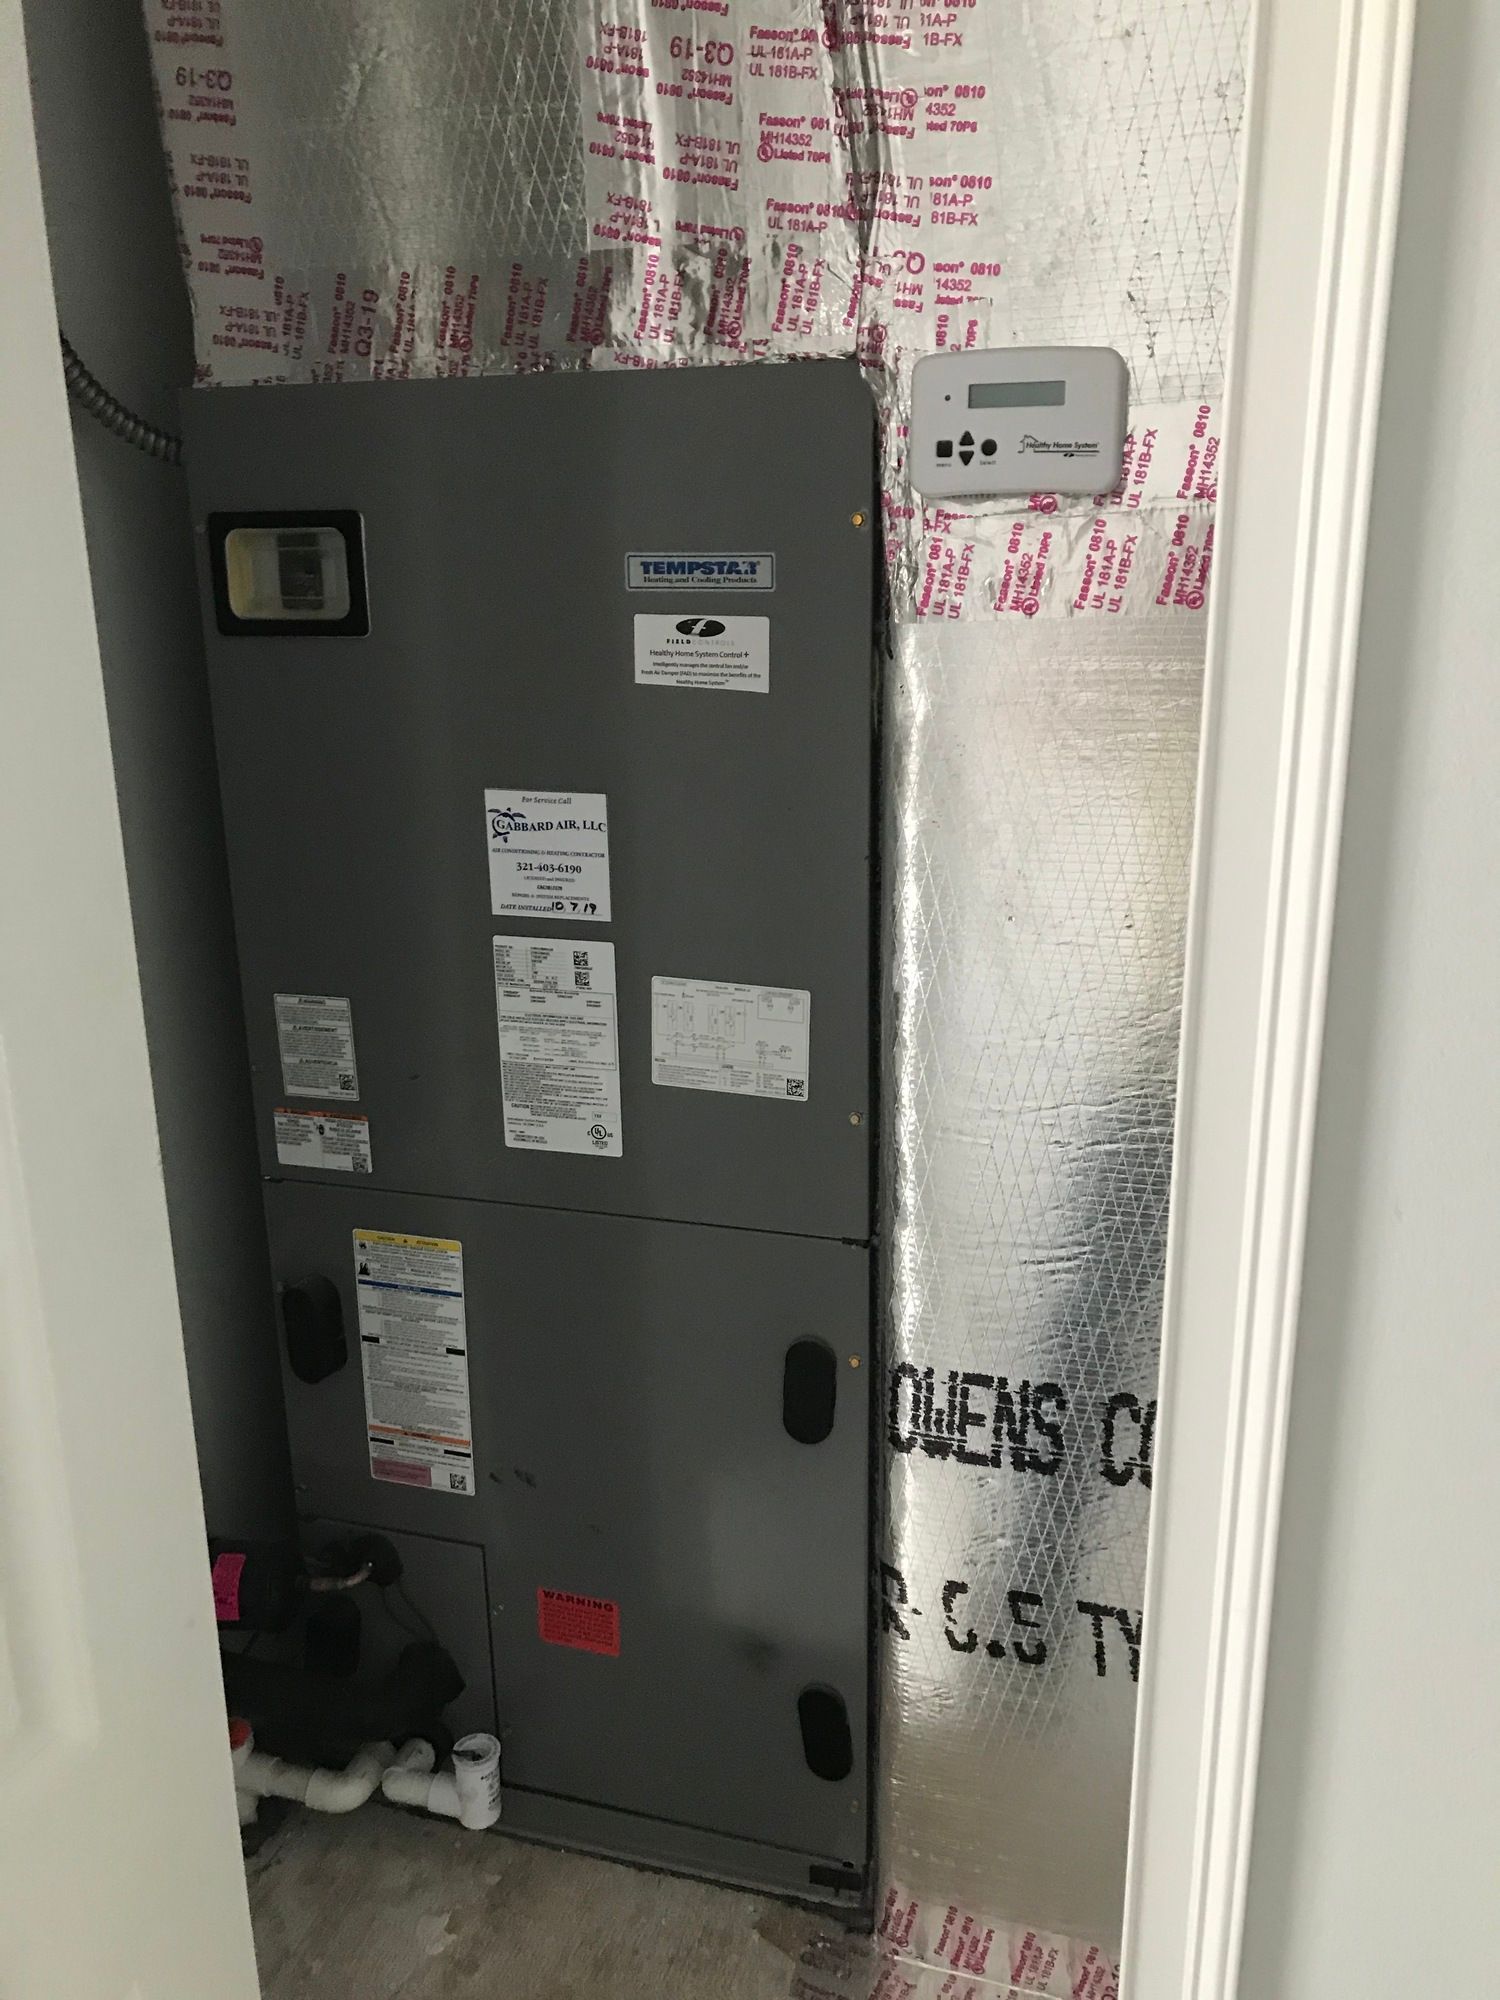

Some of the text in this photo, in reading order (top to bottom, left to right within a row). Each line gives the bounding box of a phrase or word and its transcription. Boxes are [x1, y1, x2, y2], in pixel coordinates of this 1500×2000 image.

[669, 36, 734, 66] Q3-19
[771, 46, 813, 61] 181A-P
[768, 64, 819, 80] 181B-FX
[954, 85, 986, 100] 0810
[675, 132, 741, 155] UL 181B-FX
[760, 130, 813, 147] MH14352
[679, 153, 738, 173] UL 181A-P
[960, 175, 993, 190] 0810
[768, 217, 829, 233] UL 181A-P
[644, 254, 661, 286] 0810
[783, 243, 801, 277] 0810
[970, 262, 1001, 277] 0810
[648, 273, 671, 340] UL 181A-P
[786, 263, 811, 332] UL 181A-P
[800, 258, 826, 335] UL 181B-FX
[354, 288, 380, 358] Q3-19
[936, 314, 950, 347] 0810
[1192, 405, 1212, 438] 0810
[1025, 441, 1052, 451] Healthy
[1052, 441, 1073, 449] Home
[1127, 428, 1159, 509] UL 181B-FX
[1194, 436, 1221, 502] MH14352
[1007, 522, 1025, 554] 0810
[1088, 518, 1107, 552] 0810
[1171, 514, 1190, 547] 0810
[643, 576, 673, 585] Heating
[691, 576, 721, 585] Cooling
[932, 548, 957, 616] UL 181A-P
[953, 543, 976, 598] 181B-FX
[1009, 552, 1034, 613] MH14352
[1091, 539, 1118, 610] UL 181A-P
[1107, 534, 1139, 613] UL 181B-FX
[1172, 544, 1199, 606] MH14352
[948, 602, 962, 620] UL
[649, 649, 674, 659] Healthy
[694, 650, 719, 659] System
[533, 796, 557, 805] Service
[557, 797, 572, 805] Call
[496, 819, 607, 833] GABBARD AIR, LLC
[516, 862, 582, 874] 321-403-6190
[517, 904, 553, 912] INSTALLED
[569, 901, 579, 912] 7
[584, 903, 597, 915] 19
[889, 1360, 1064, 1476] OWENS
[542, 1590, 615, 1613] WARNING
